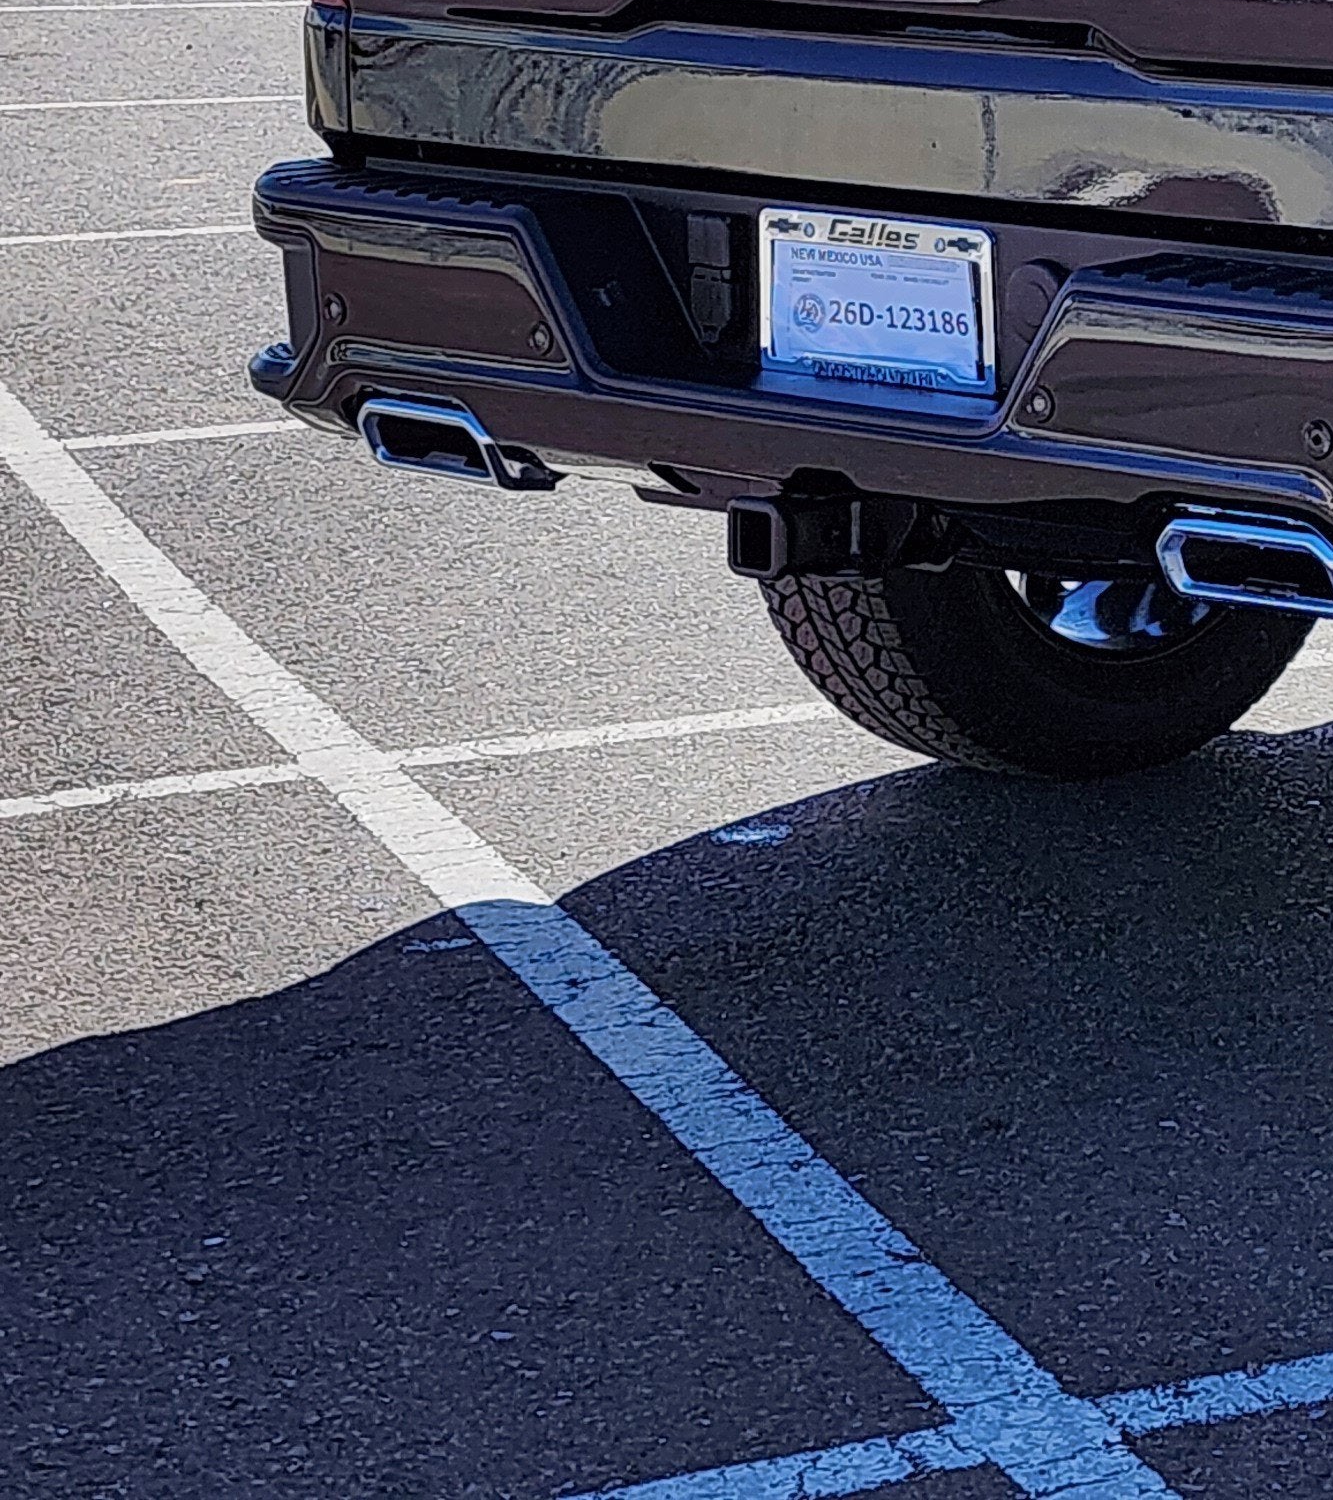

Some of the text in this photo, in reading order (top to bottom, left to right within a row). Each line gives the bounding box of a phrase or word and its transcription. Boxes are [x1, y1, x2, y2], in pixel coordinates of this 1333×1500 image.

[827, 218, 920, 250] Galles
[791, 247, 816, 261] NEW
[818, 249, 859, 265] MEXICO
[860, 253, 883, 267] USA
[829, 300, 969, 336] 26D-123186
